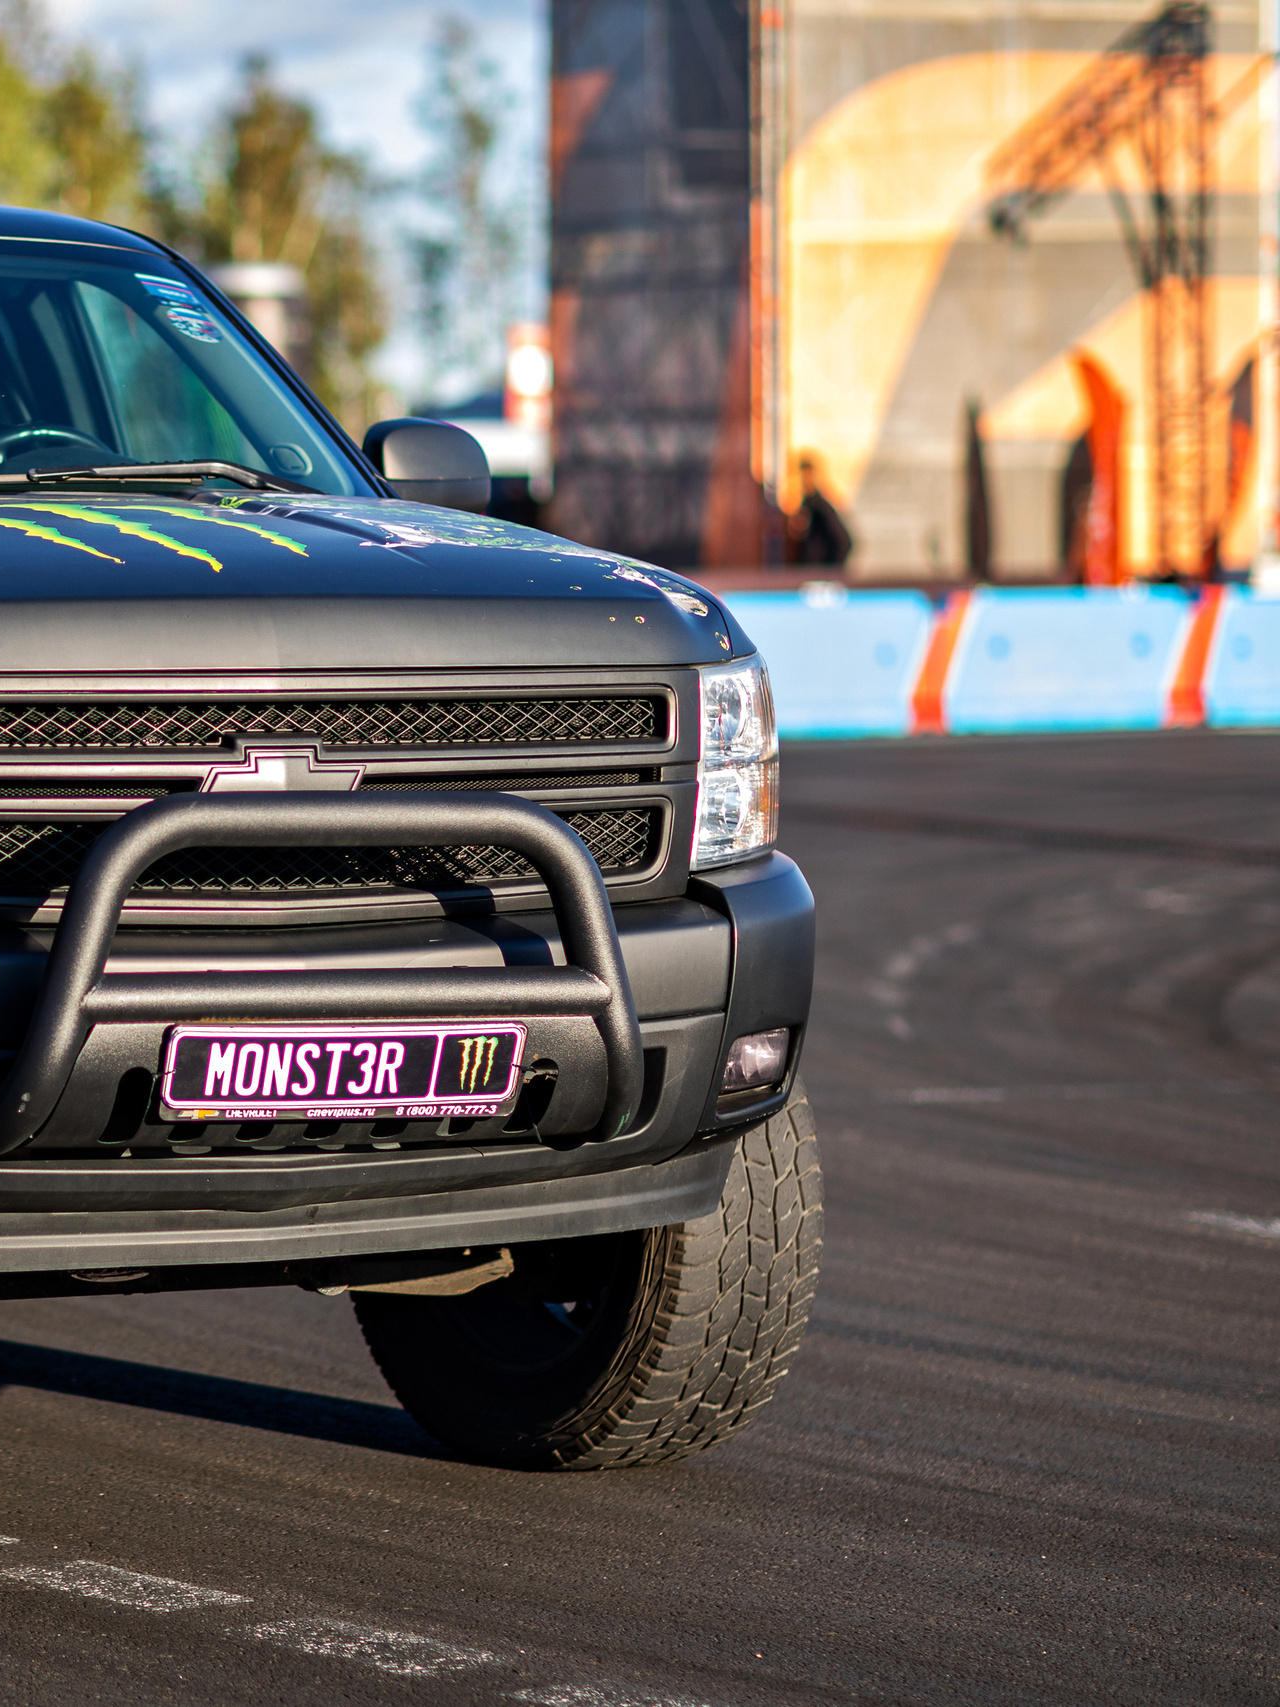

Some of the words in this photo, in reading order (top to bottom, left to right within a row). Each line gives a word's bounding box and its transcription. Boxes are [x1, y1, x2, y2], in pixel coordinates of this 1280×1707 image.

[204, 1042, 406, 1097] MONST3R
[395, 1106, 405, 1116] 8
[406, 1105, 437, 1116] (800)
[439, 1105, 497, 1115] 770-777-3
